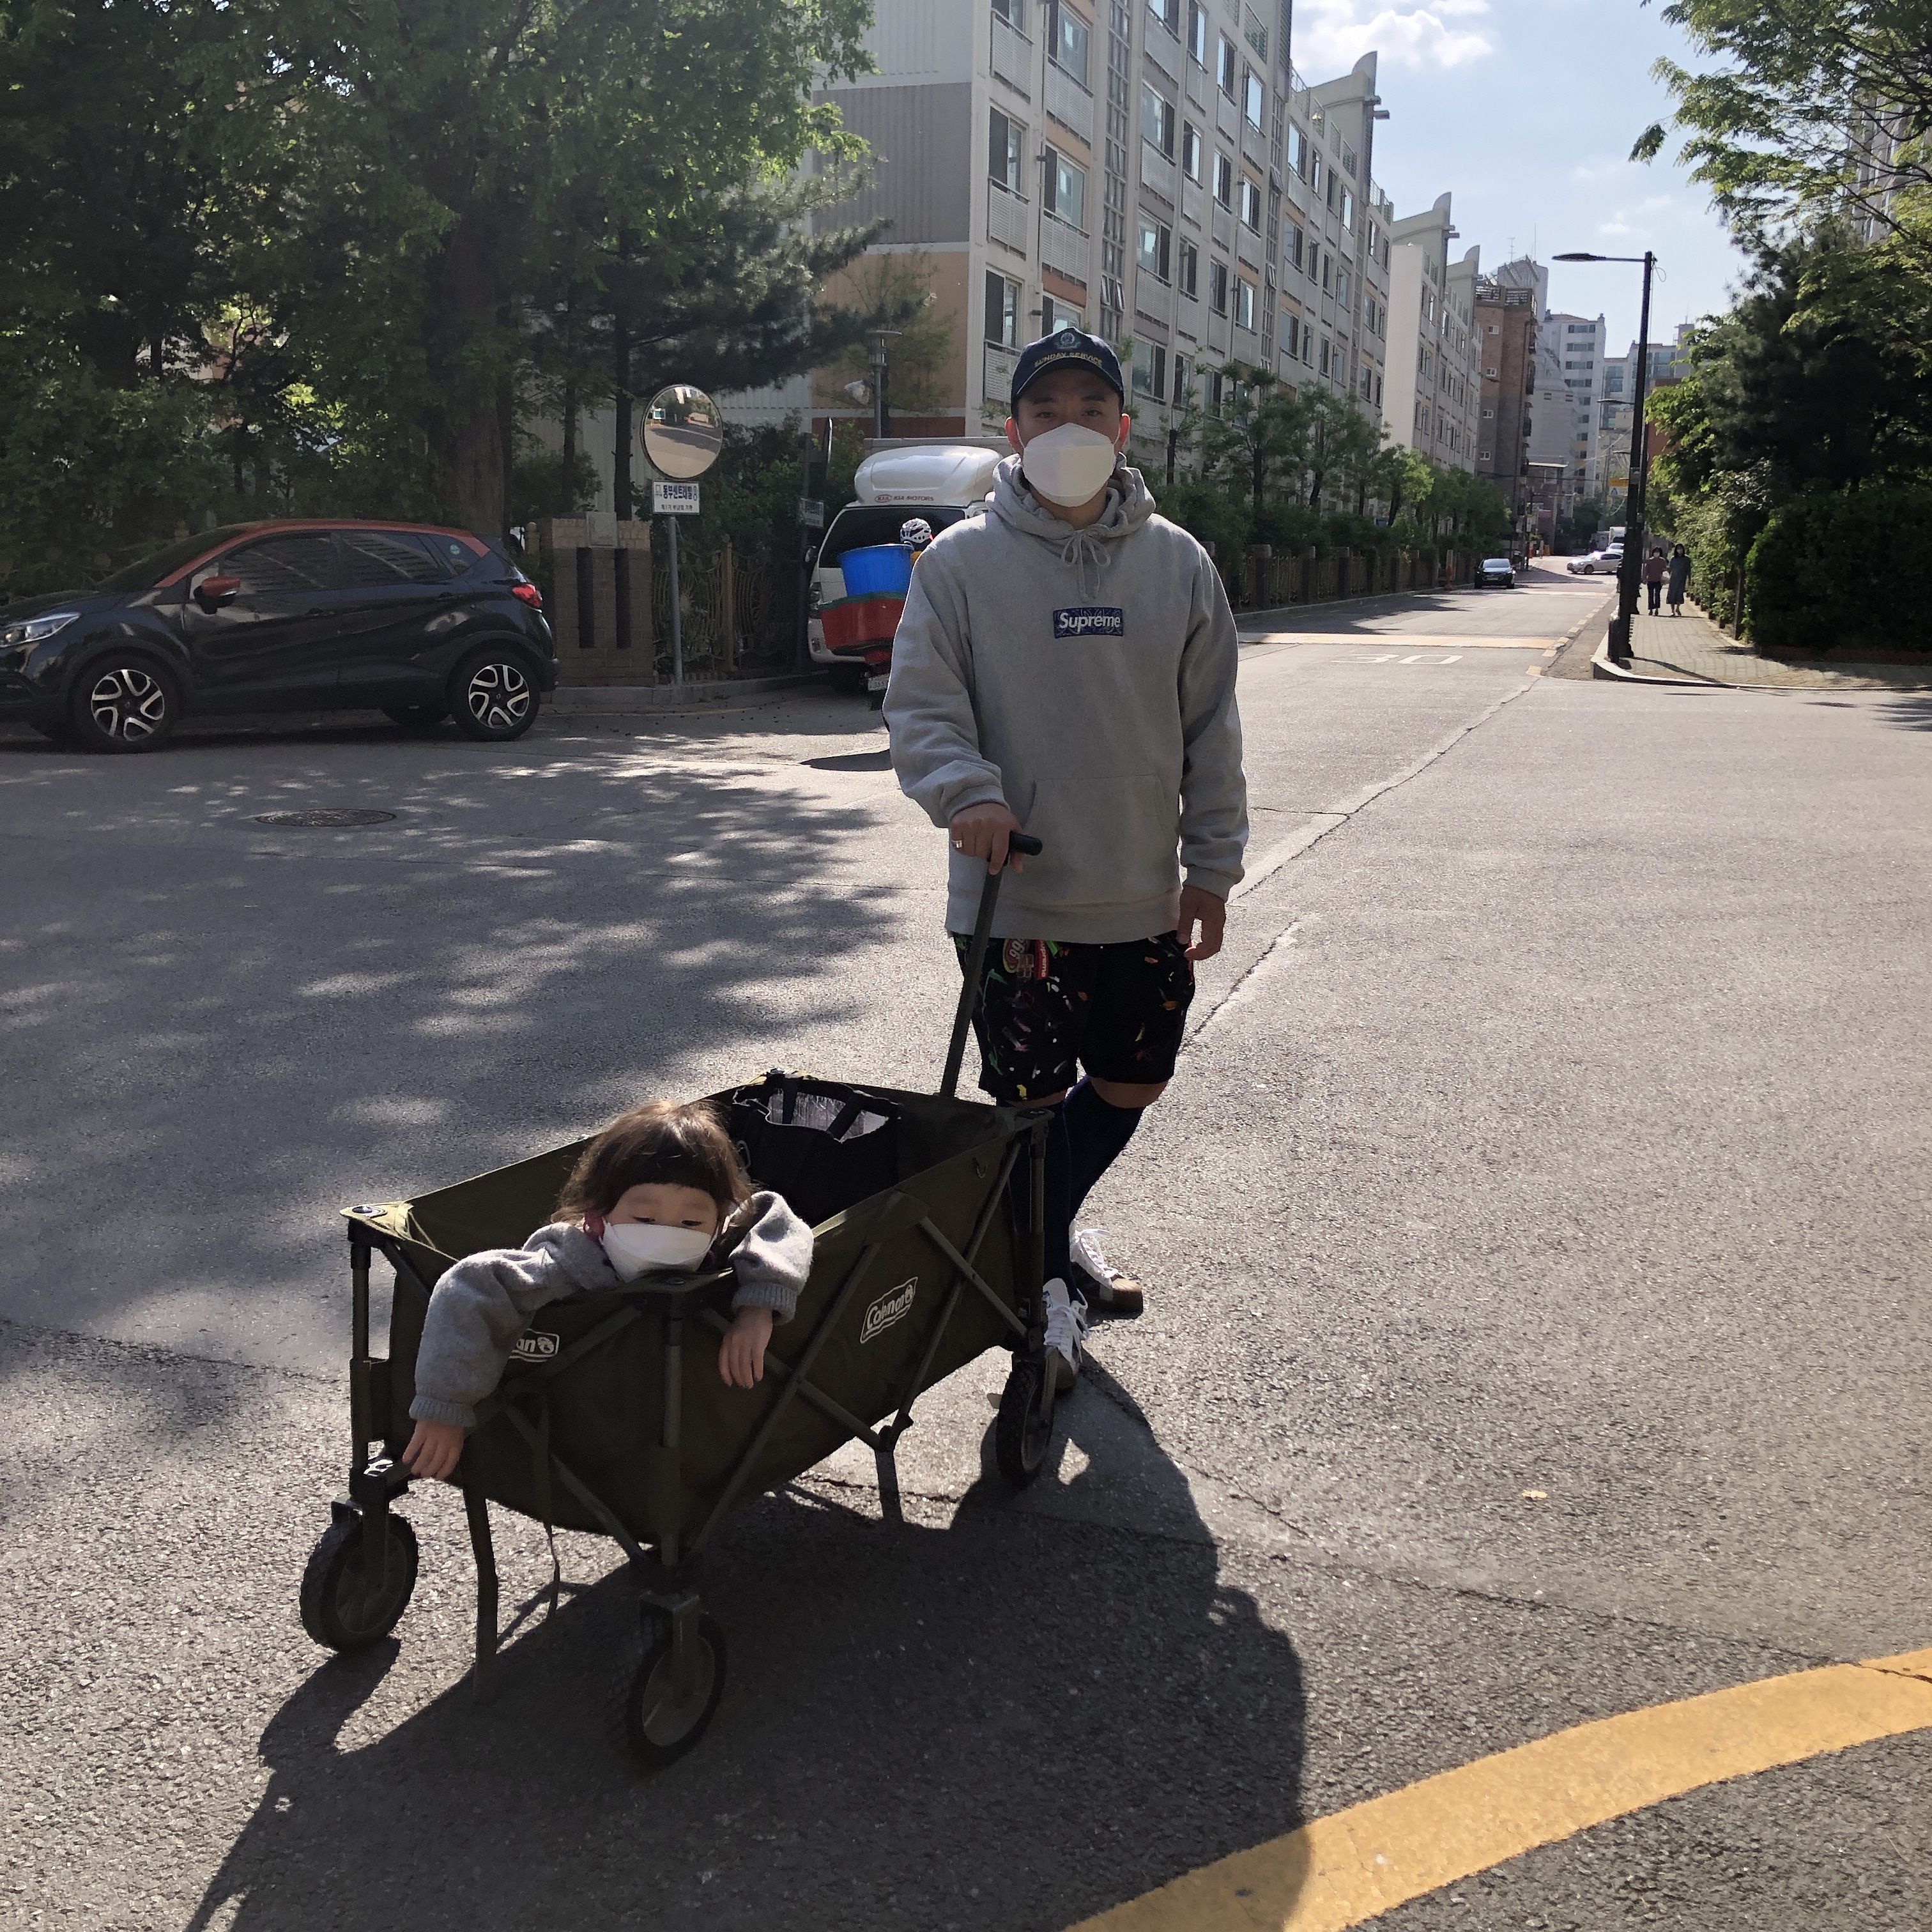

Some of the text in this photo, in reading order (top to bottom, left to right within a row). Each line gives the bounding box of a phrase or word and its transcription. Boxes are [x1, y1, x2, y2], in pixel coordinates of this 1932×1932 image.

[1034, 352, 1103, 368] SUNDAY SERVICE
[1059, 612, 1121, 633] Supreme
[1331, 653, 1464, 664] 30
